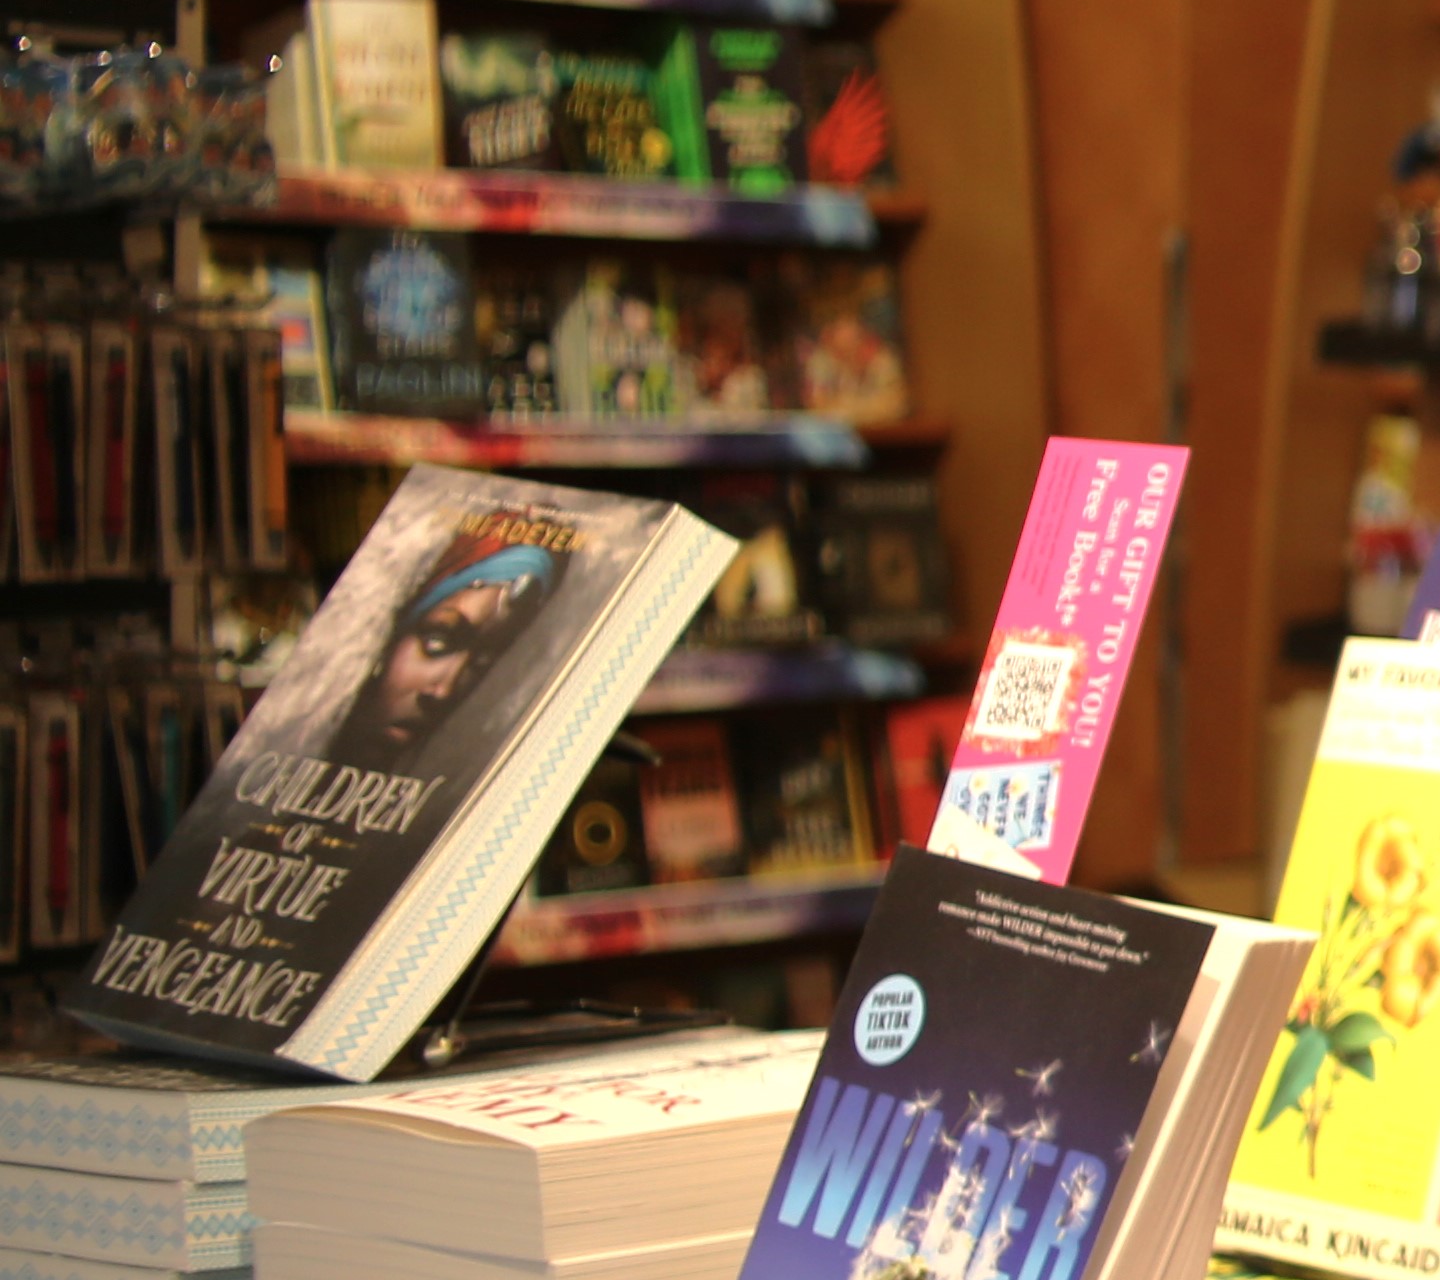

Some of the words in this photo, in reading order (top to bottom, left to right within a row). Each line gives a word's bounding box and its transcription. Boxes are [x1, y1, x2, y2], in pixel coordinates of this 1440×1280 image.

[1083, 458, 1119, 523] Free
[1137, 462, 1170, 531] OUR
[1112, 541, 1151, 614] GIFT
[1097, 620, 1124, 664] TO
[1071, 673, 1113, 749] YOU!
[235, 751, 447, 835] CHILDREN
[283, 822, 325, 853] OF
[198, 836, 350, 922] VIRTUE
[209, 914, 264, 949] AND
[1003, 915, 1043, 938] WILDER
[92, 924, 321, 1027] VENGEANCE
[872, 991, 914, 1008] POPULAR
[865, 1034, 903, 1051] AUTHOR
[867, 1010, 911, 1031] TIKTOK
